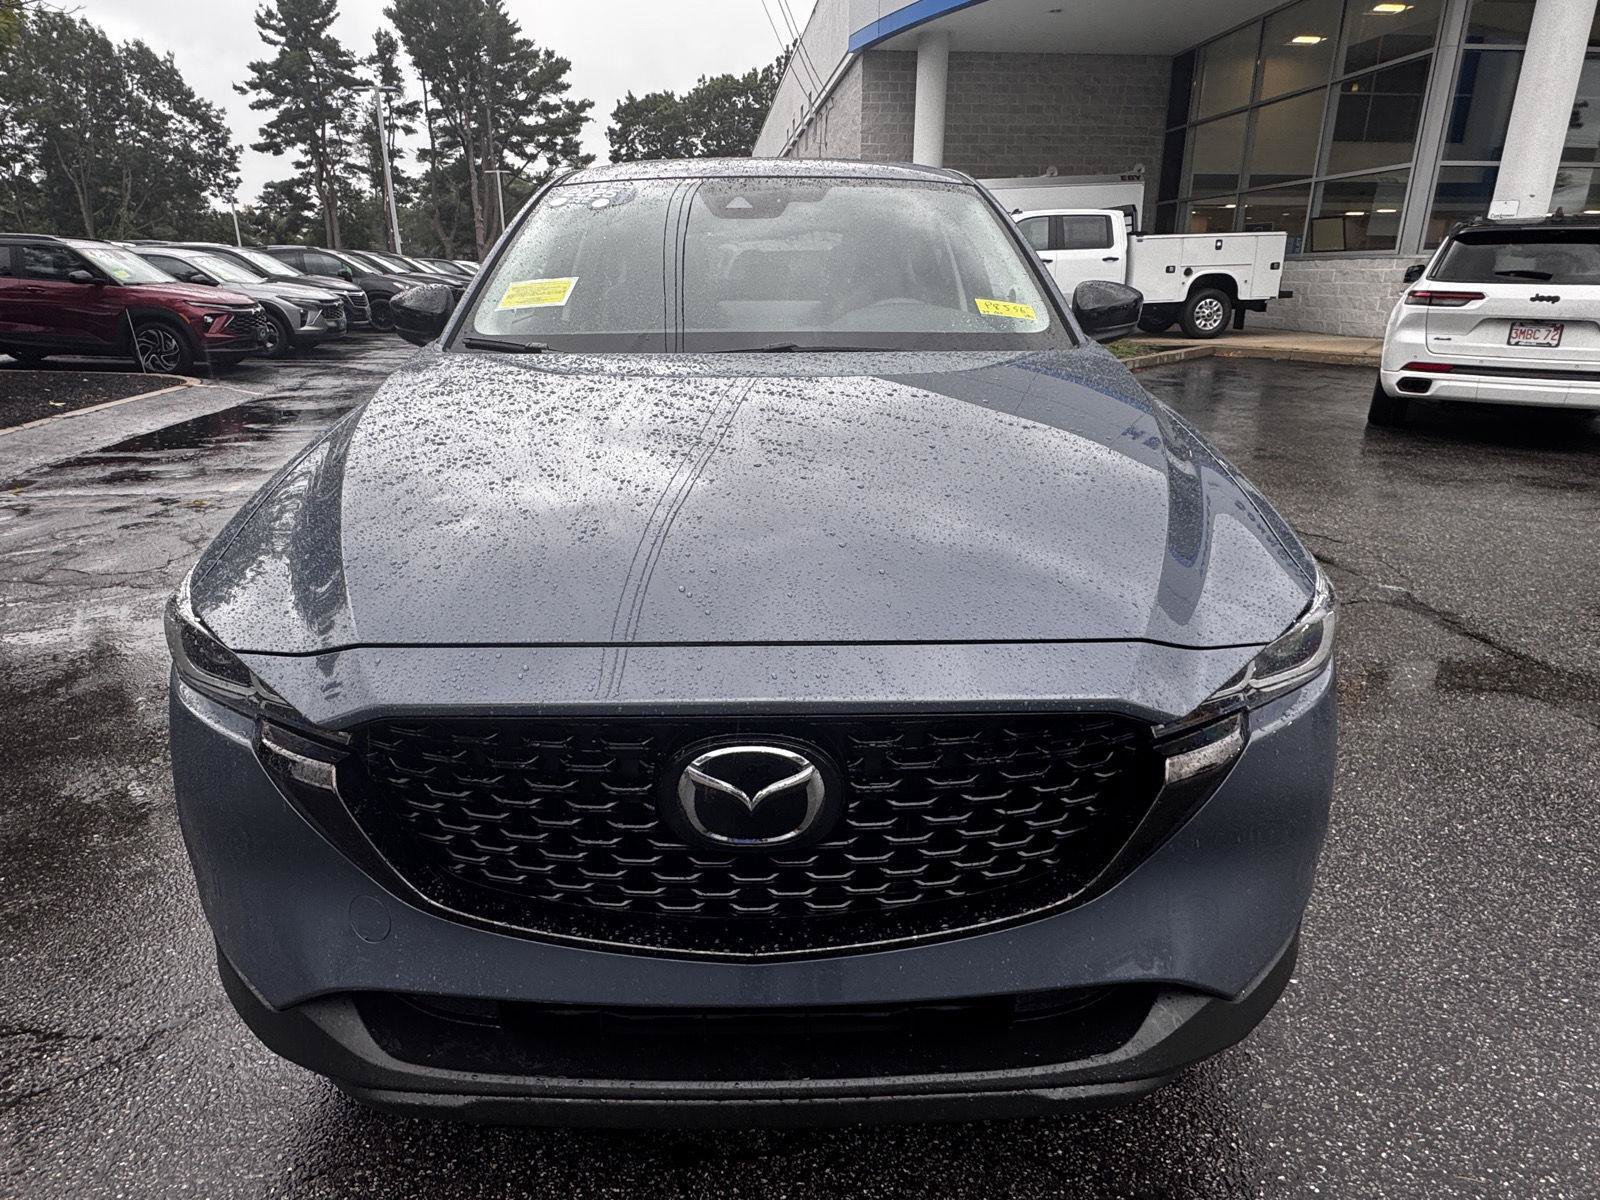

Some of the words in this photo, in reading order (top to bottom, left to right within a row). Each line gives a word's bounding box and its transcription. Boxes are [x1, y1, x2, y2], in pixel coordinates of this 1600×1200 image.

[1529, 293, 1561, 304] Jeep
[1511, 328, 1541, 340] 3MBC
[1543, 329, 1559, 341] 72
